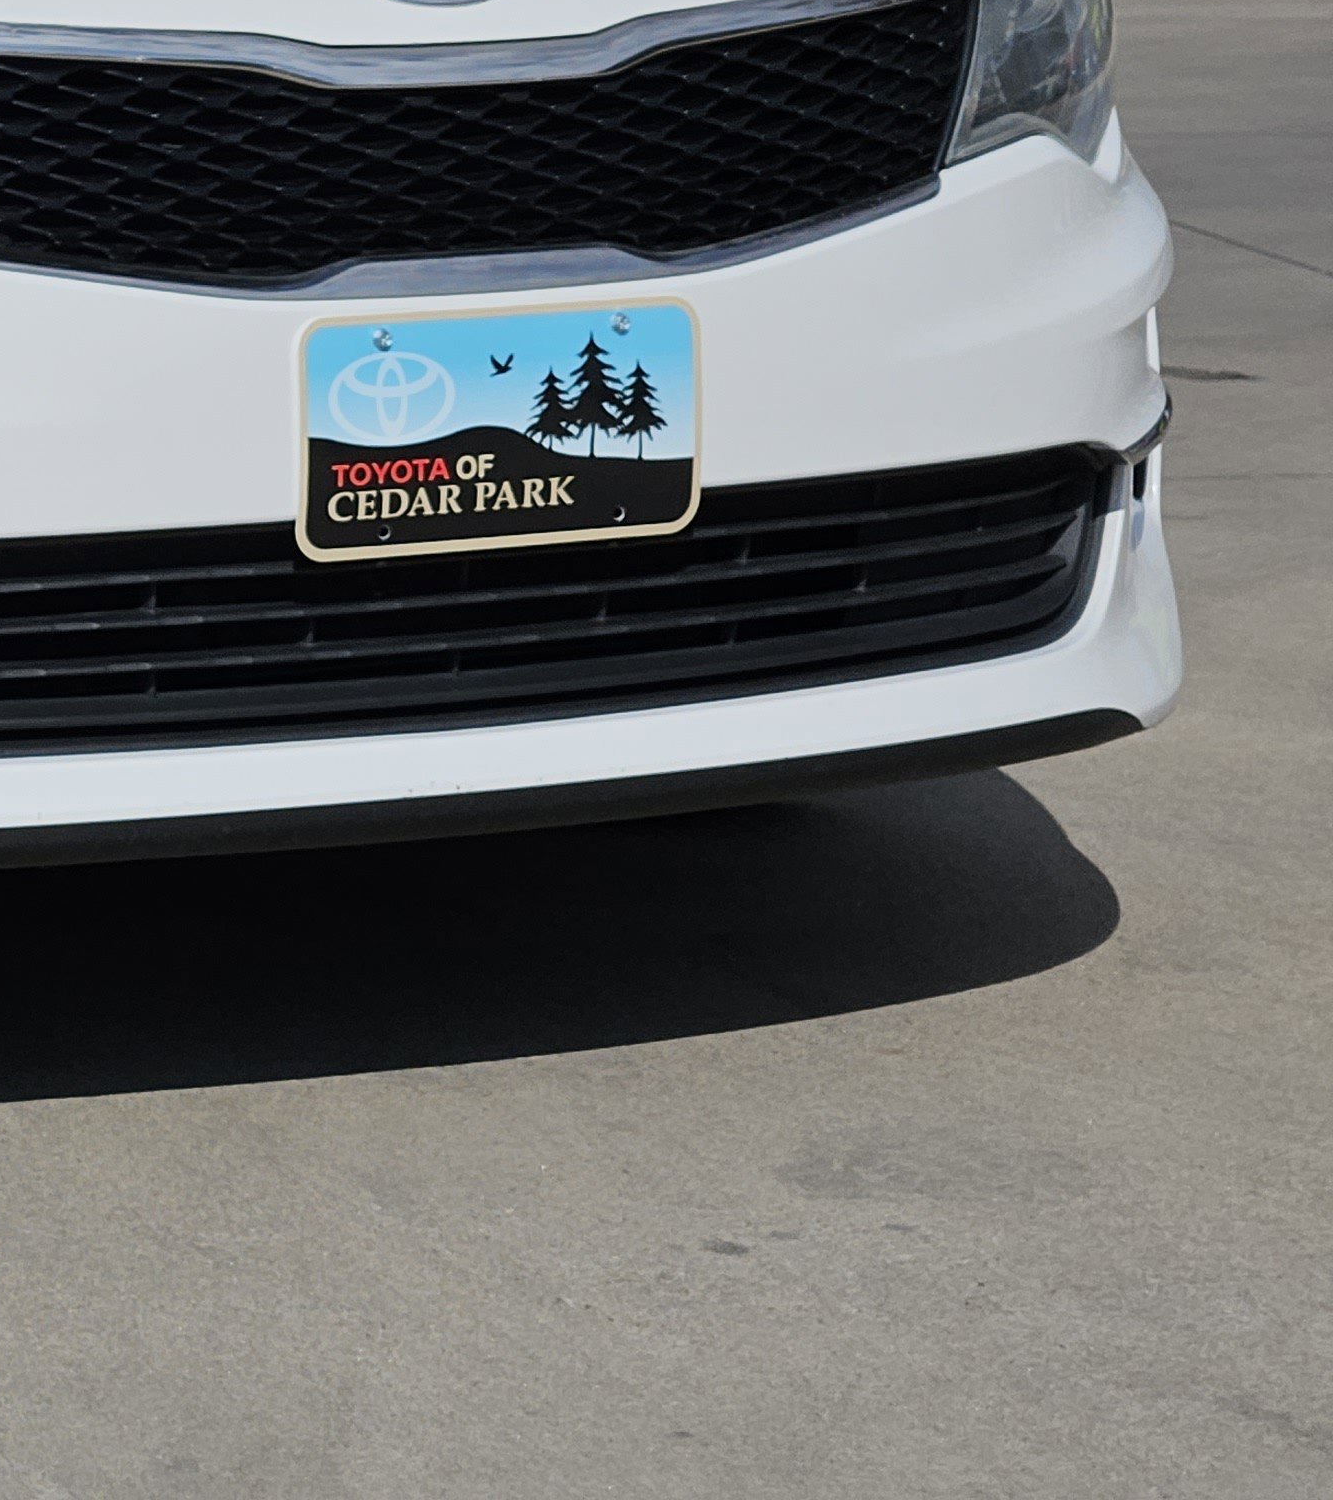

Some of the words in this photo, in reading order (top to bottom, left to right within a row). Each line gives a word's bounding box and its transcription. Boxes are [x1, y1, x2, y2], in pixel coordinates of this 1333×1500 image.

[331, 457, 450, 488] TOYOTA
[455, 453, 495, 481] OF
[327, 484, 463, 523] CEDAR
[474, 475, 575, 513] PARK
